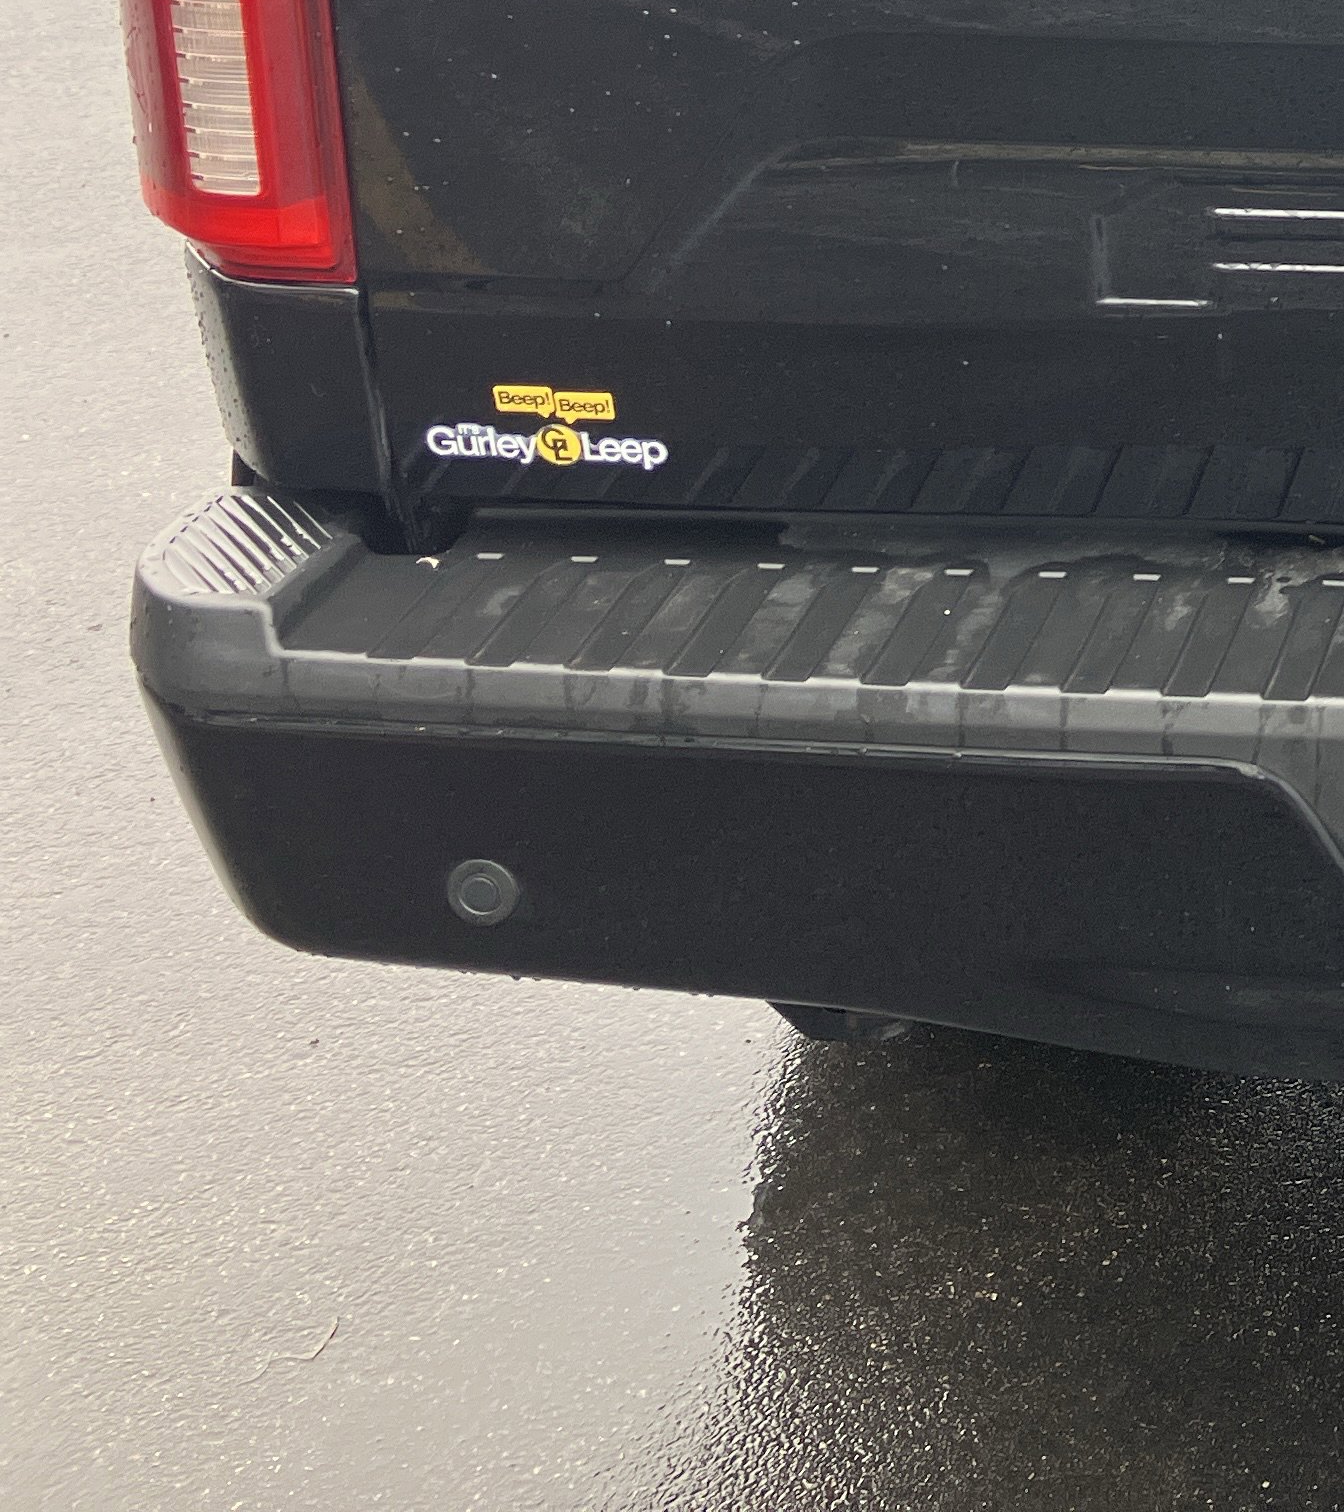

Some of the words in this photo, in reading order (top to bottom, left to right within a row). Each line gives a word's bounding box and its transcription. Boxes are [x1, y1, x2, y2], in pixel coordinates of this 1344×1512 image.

[498, 391, 550, 409] Beep!
[559, 399, 610, 415] Beep!
[580, 431, 668, 470] Leep
